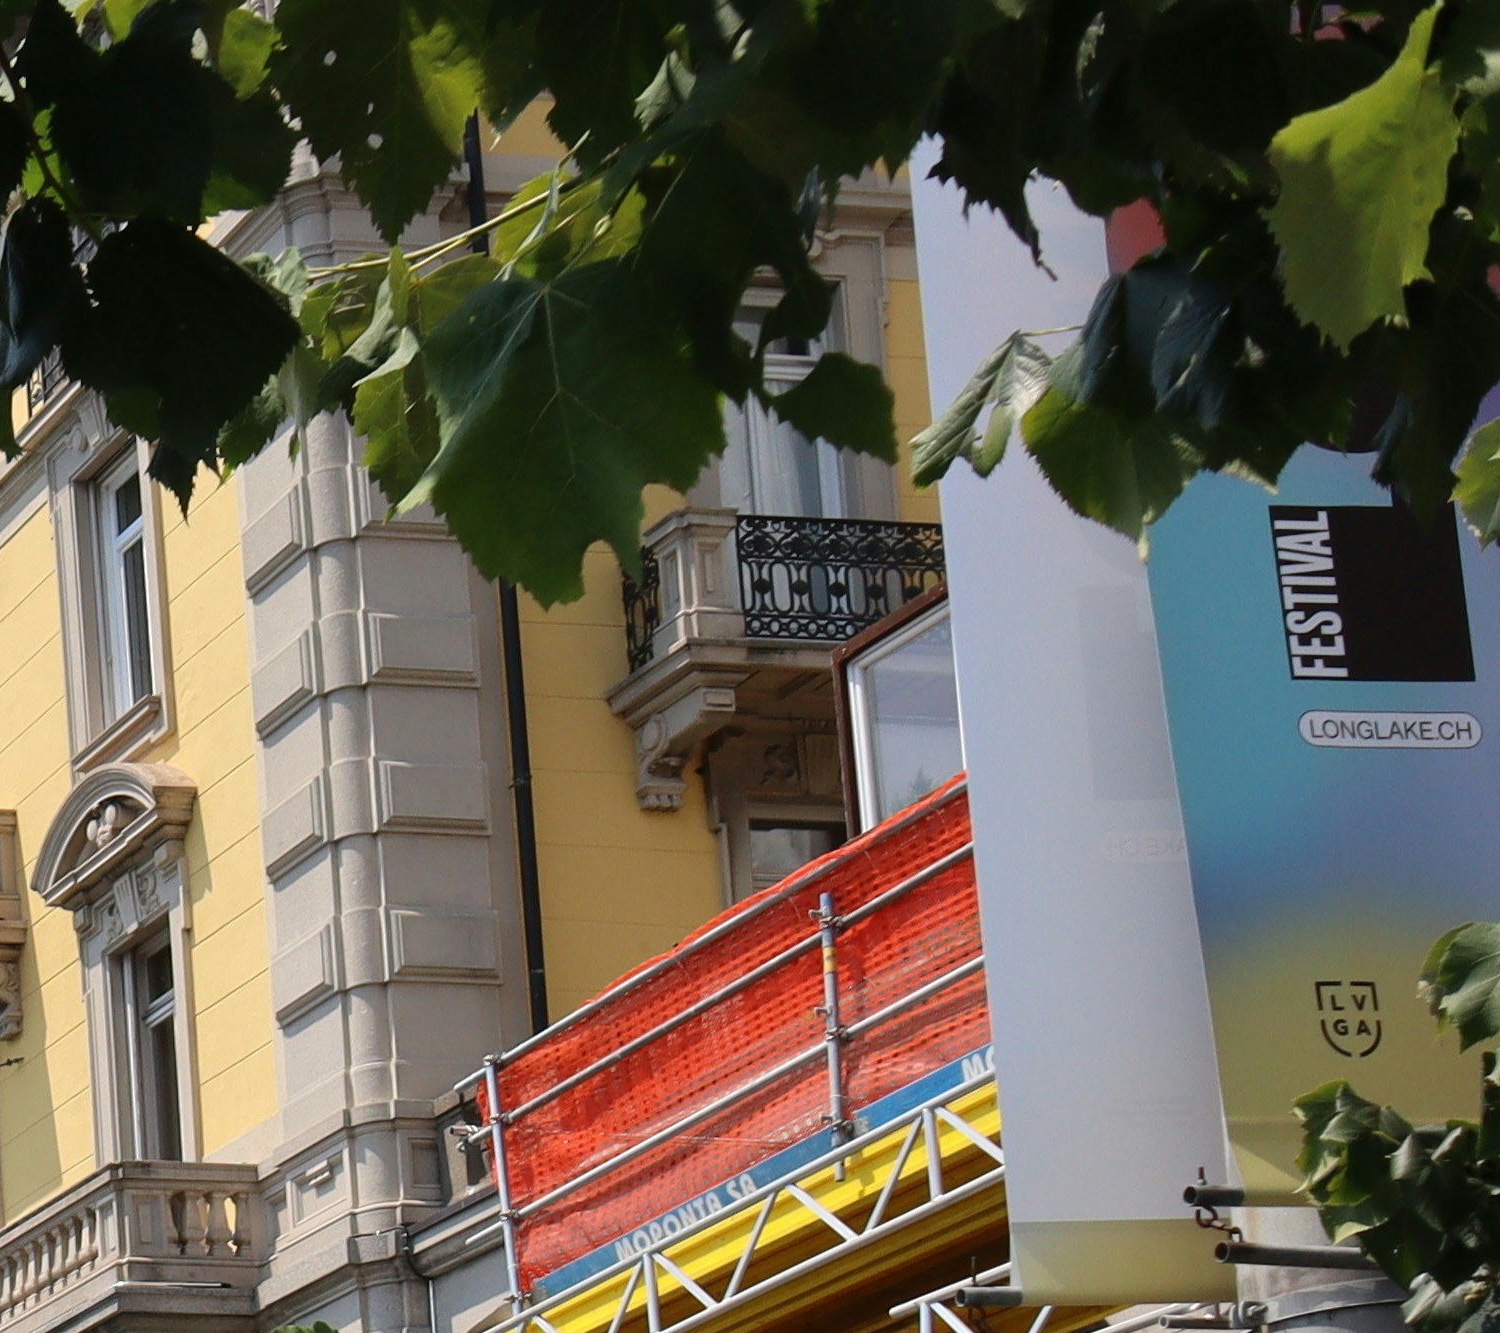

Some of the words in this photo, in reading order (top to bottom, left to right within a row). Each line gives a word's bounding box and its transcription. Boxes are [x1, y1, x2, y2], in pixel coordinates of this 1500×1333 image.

[1274, 510, 1349, 678] FESTIVAL
[1308, 718, 1473, 741] LONGLAKE.CH
[614, 1191, 722, 1261] MOPONTA
[726, 1172, 757, 1201] SA
